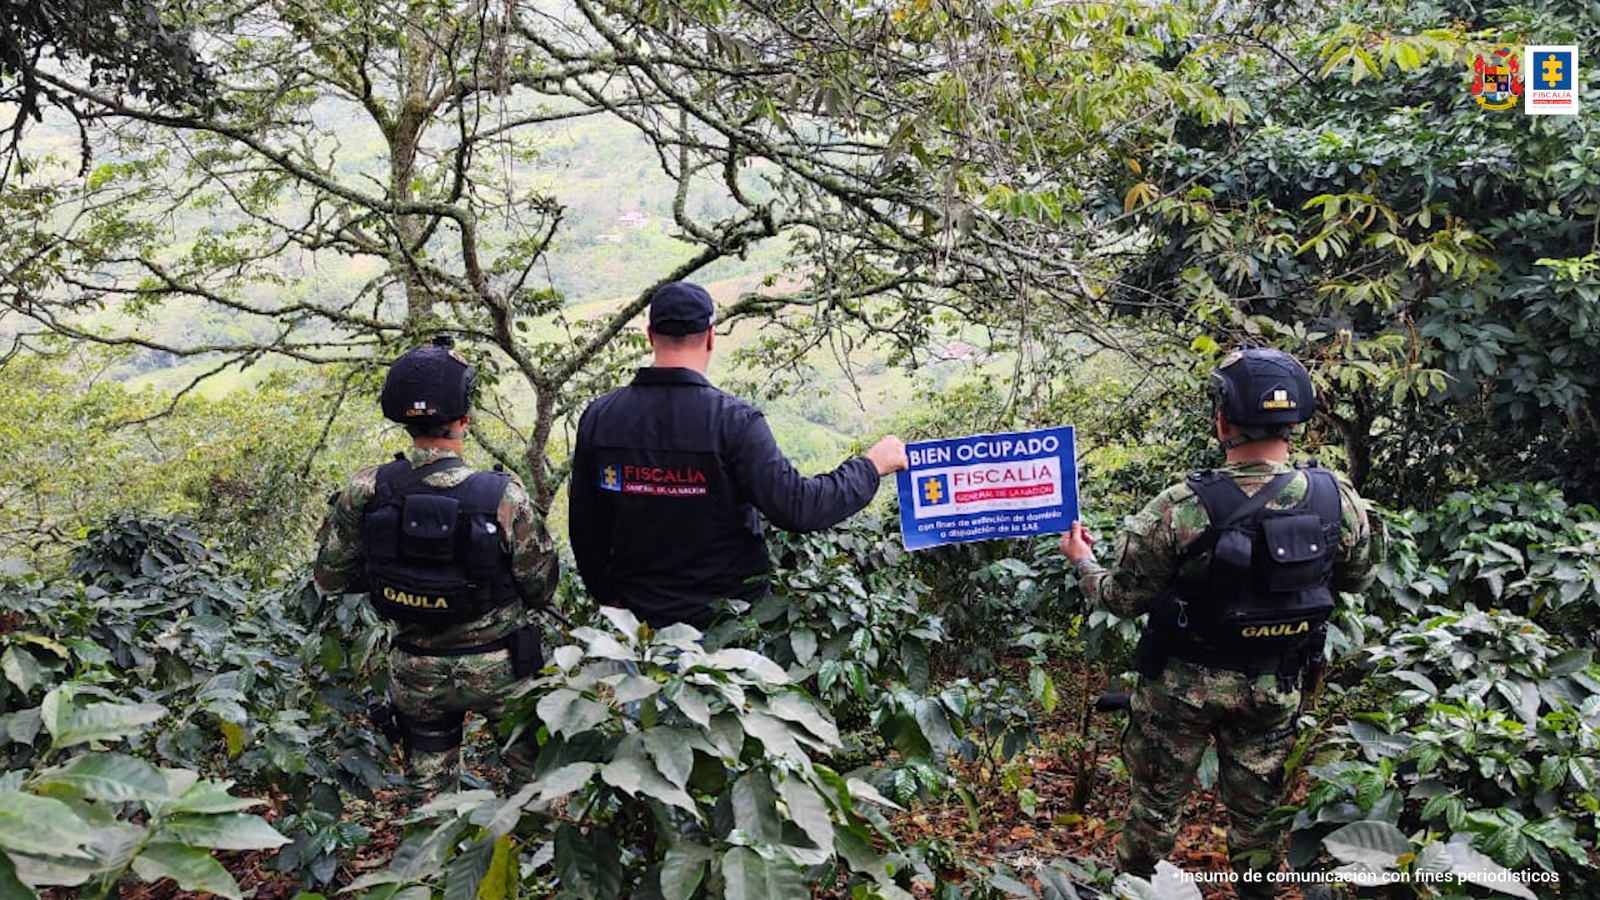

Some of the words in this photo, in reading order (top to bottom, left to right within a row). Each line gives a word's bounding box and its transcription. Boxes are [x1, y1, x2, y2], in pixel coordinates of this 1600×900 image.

[910, 447, 950, 466] BIEN
[957, 436, 1059, 461] OCUPADO
[956, 491, 993, 501] GENERAL
[918, 524, 934, 532] con
[936, 520, 956, 528] fines
[1013, 514, 1025, 522] de
[1027, 509, 1062, 520] dominio
[998, 524, 1010, 532] de
[1012, 523, 1020, 531] la
[383, 587, 449, 608] GAULA
[1241, 621, 1309, 638] GAULA
